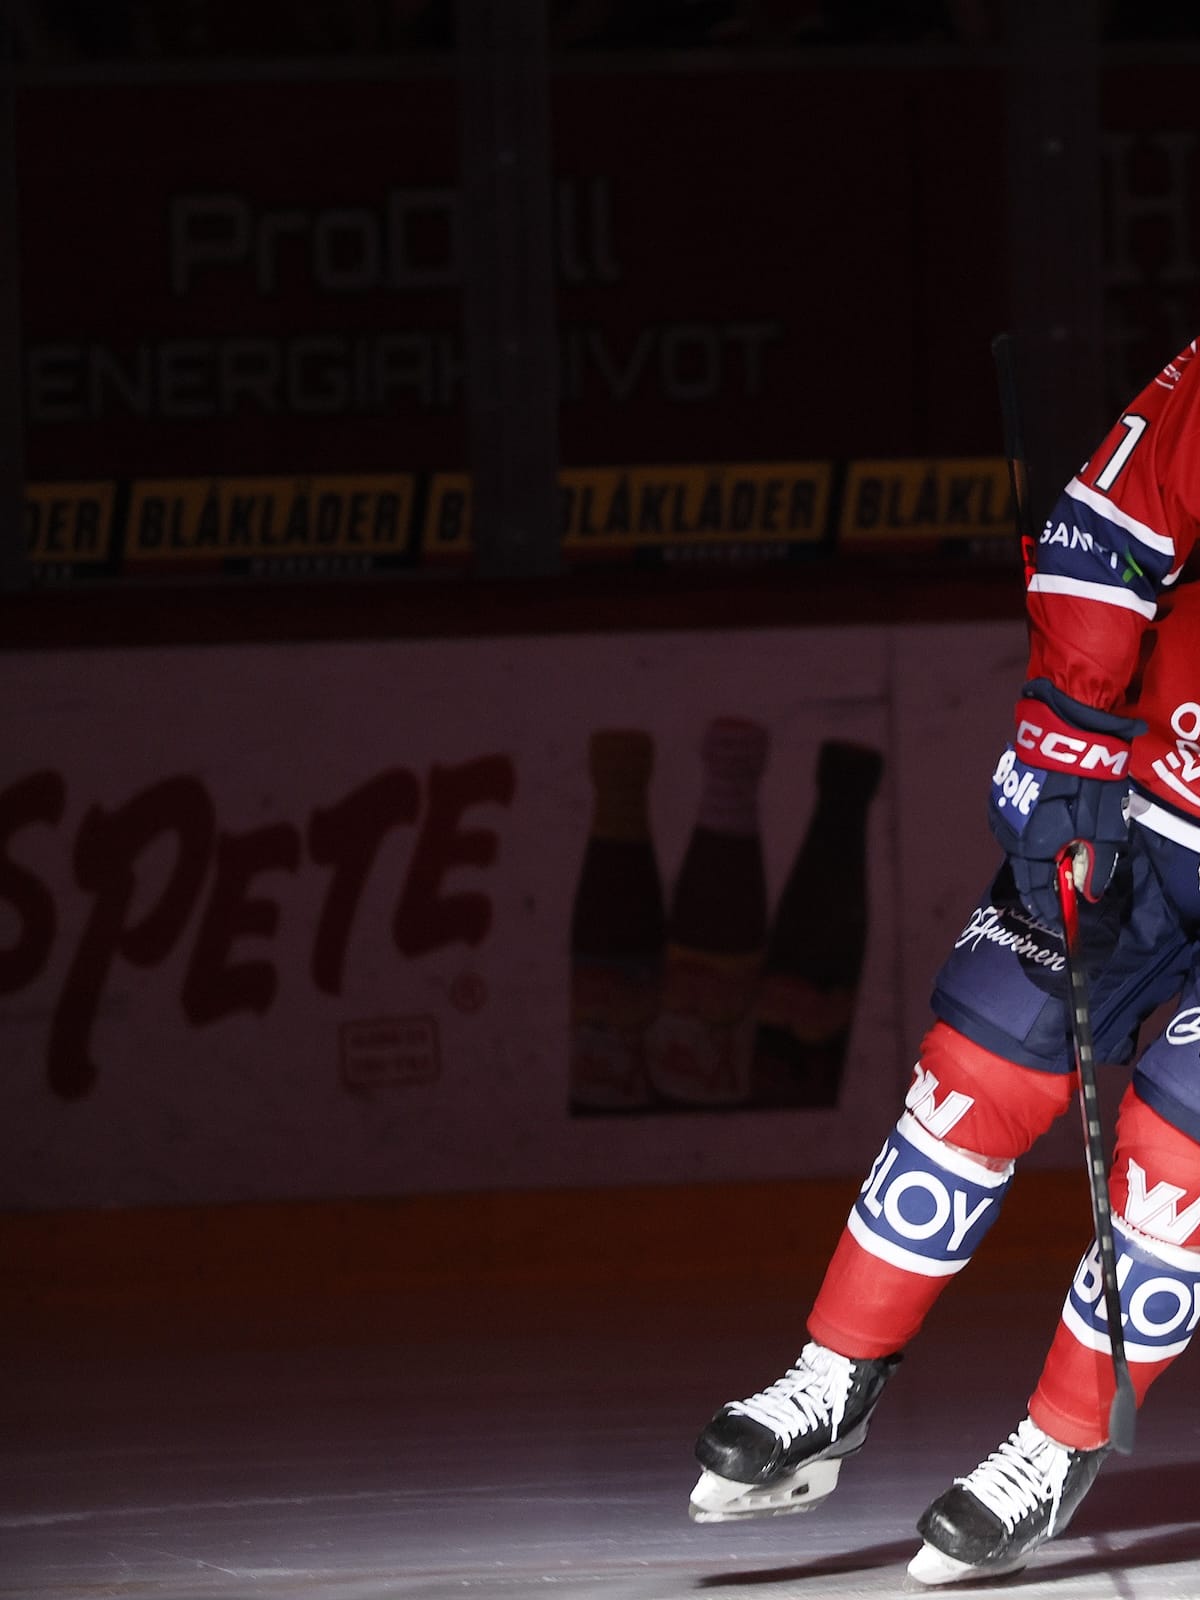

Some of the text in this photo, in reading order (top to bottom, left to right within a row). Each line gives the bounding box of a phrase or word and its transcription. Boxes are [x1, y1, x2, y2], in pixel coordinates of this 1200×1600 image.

[139, 486, 402, 551] BLÅKLÄDER
[1017, 720, 1129, 776] CCM
[992, 749, 1040, 816] Bolt
